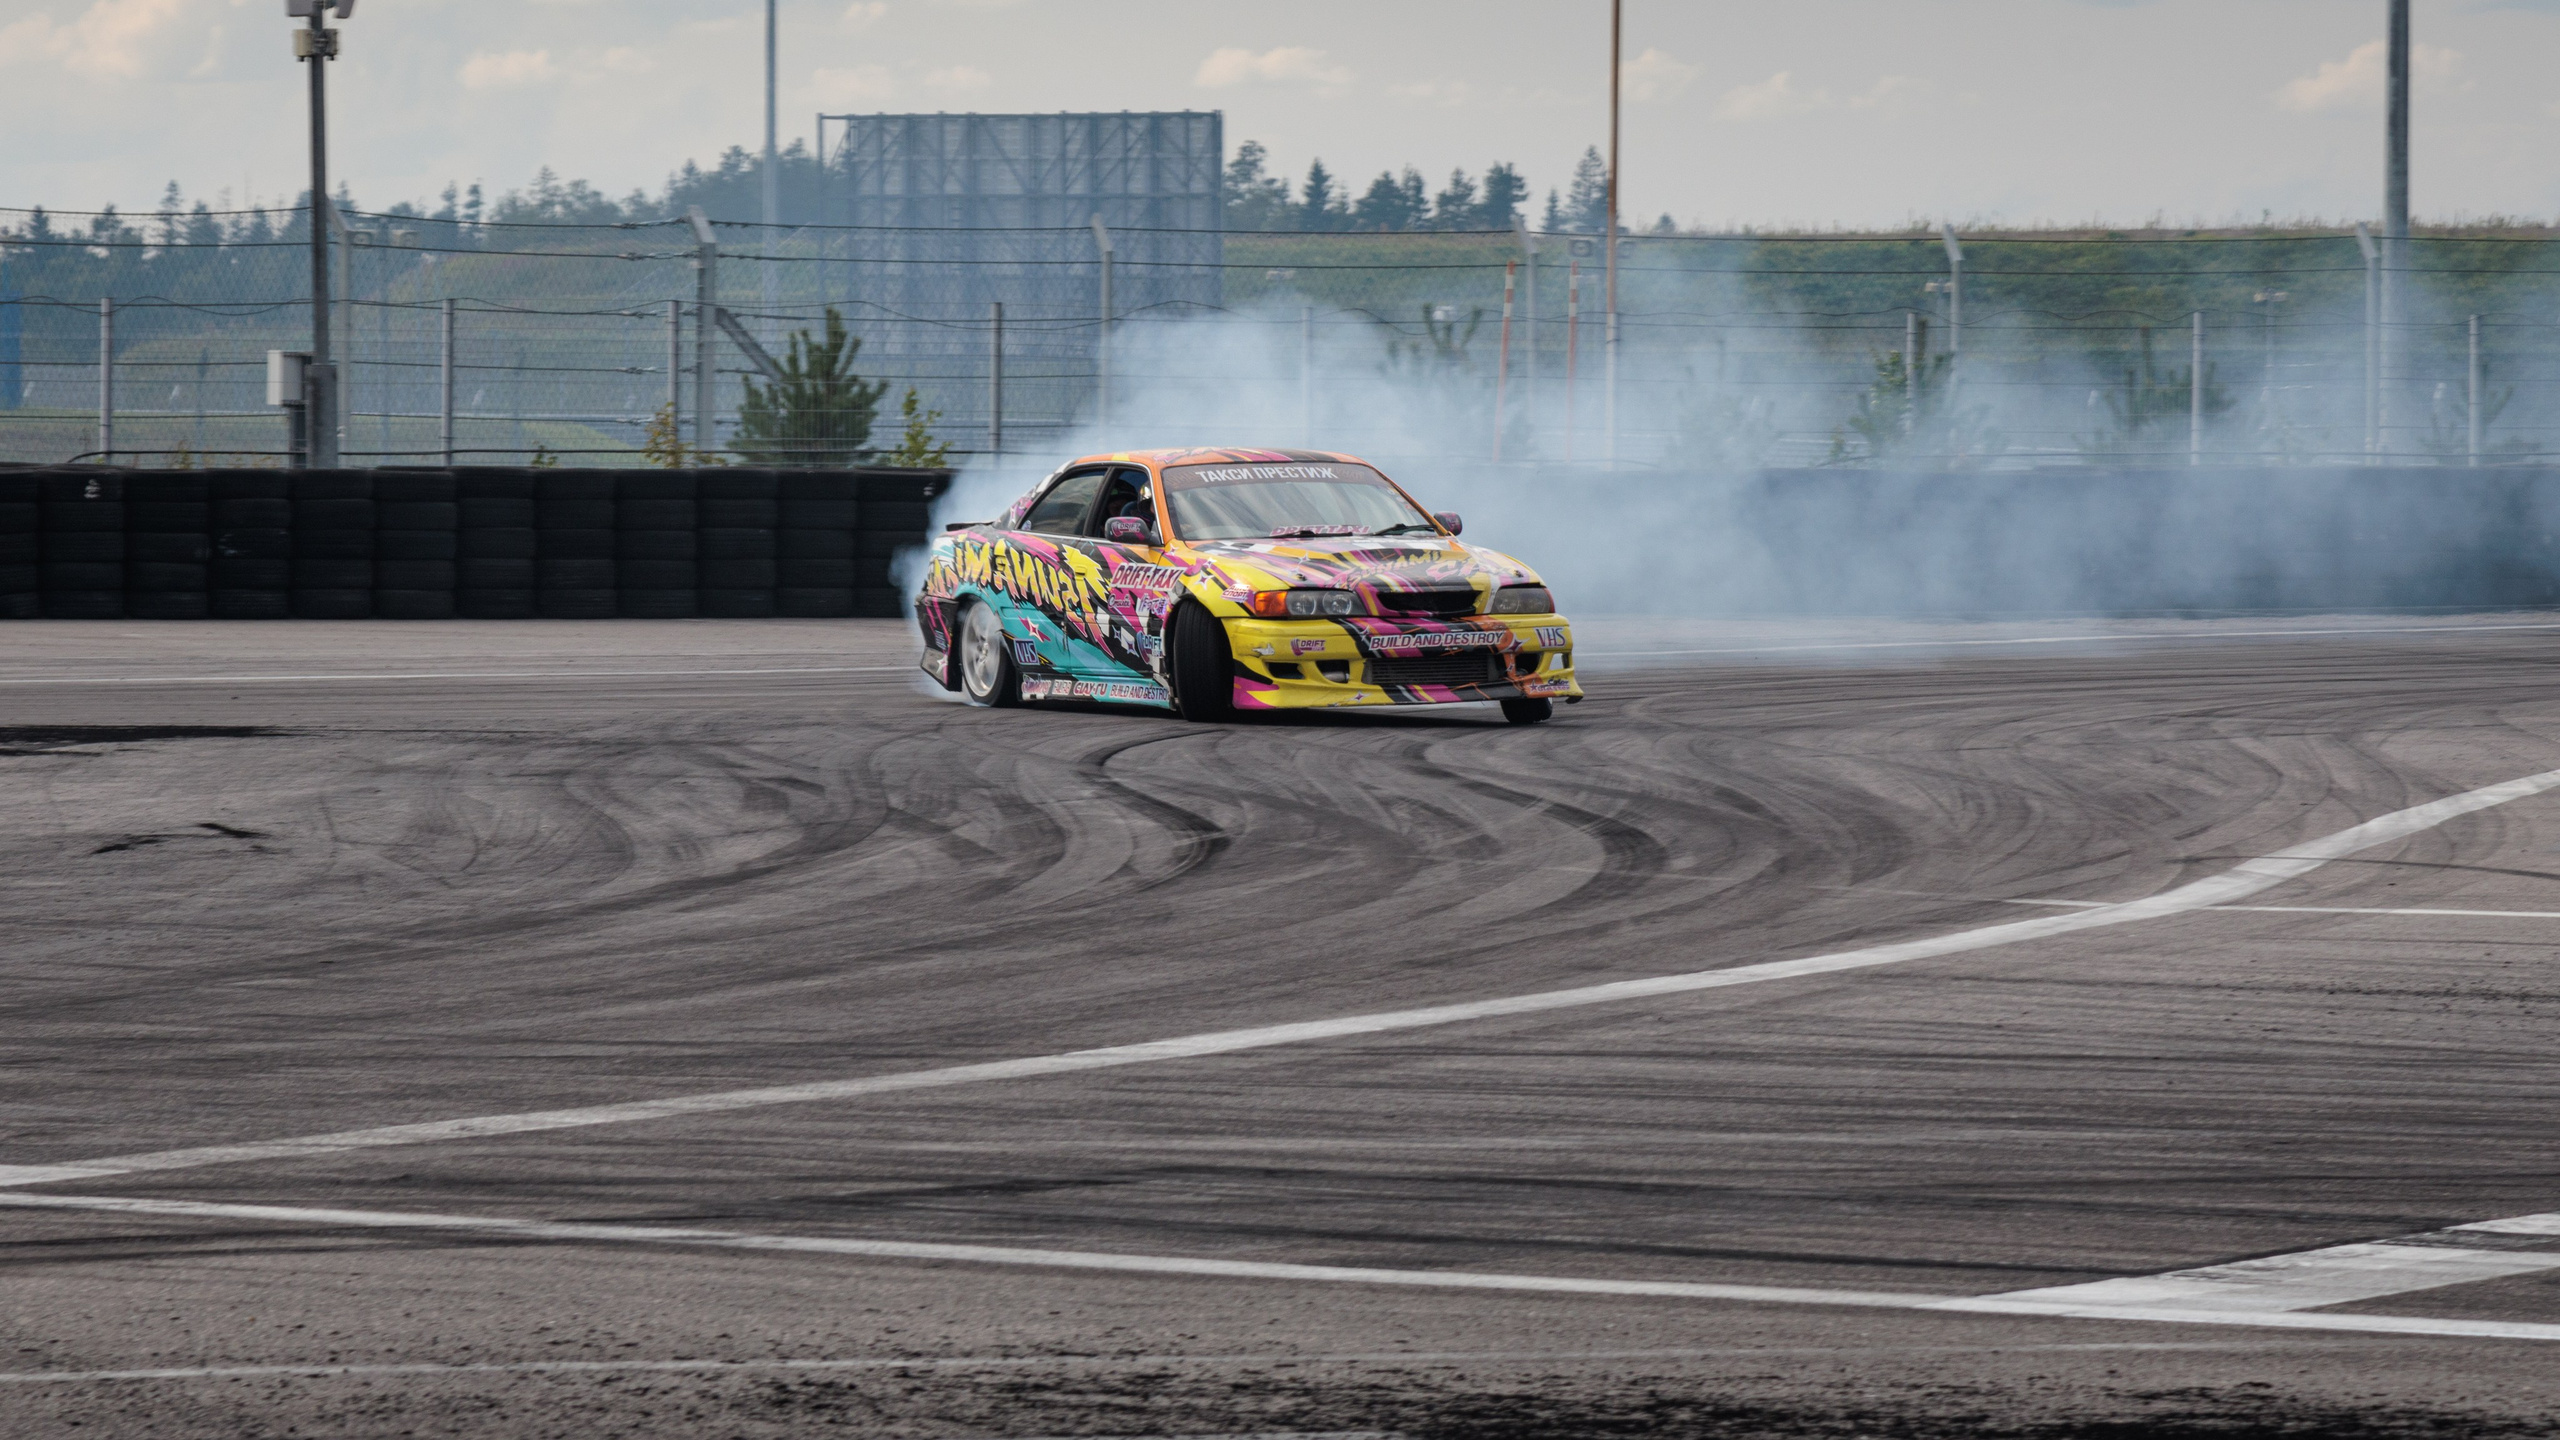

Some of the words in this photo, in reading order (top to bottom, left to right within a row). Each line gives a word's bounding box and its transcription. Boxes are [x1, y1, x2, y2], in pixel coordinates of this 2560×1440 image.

[1195, 467, 1254, 483] ТАКСИ
[1252, 465, 1339, 480] ПРЕСТИЖ
[1270, 525, 1323, 536] DRIFT
[1327, 525, 1371, 534] TAXI
[1300, 639, 1326, 648] DRIFT
[1370, 634, 1411, 650] BUILD
[1409, 633, 1442, 648] AND
[1444, 631, 1504, 647] DESTROY
[1535, 626, 1566, 648] VHS
[1015, 640, 1039, 664] VHS
[1111, 684, 1129, 698] BUILD
[1129, 685, 1144, 699] AND
